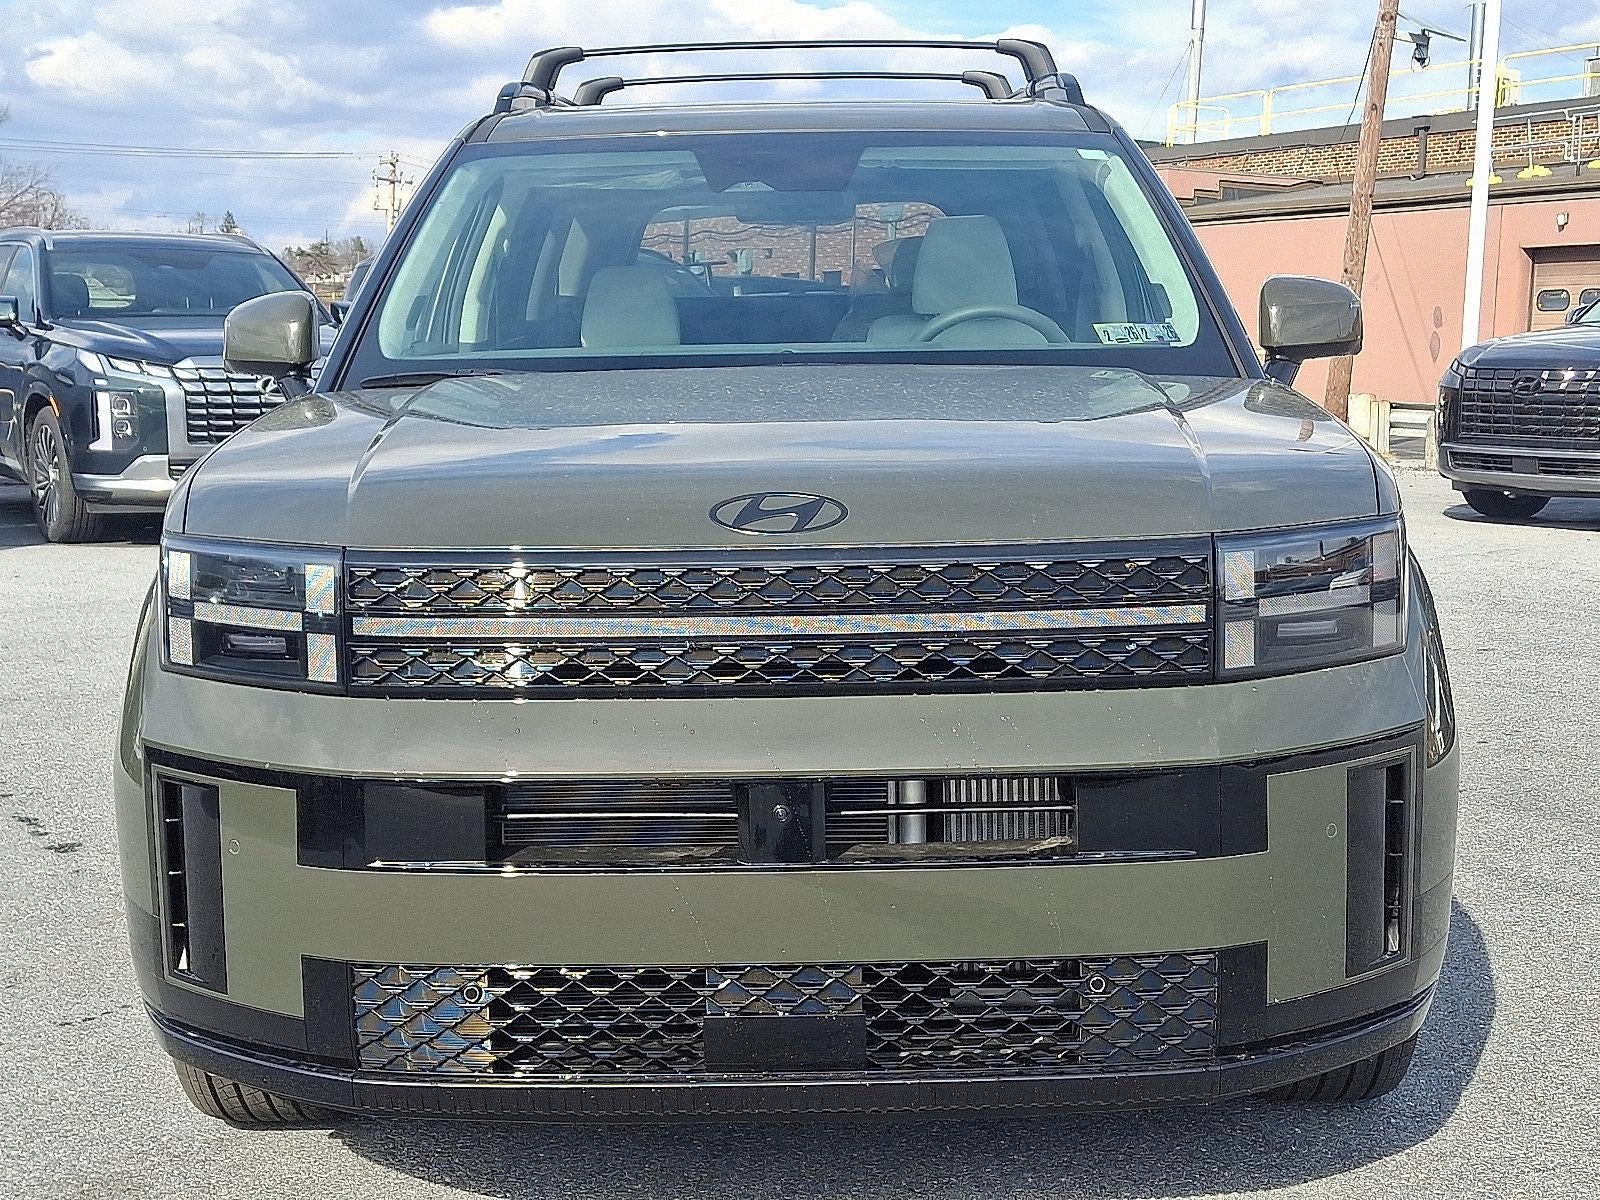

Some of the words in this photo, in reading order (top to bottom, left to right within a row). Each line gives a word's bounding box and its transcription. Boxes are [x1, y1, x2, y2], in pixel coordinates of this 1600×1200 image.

[1103, 330, 1113, 341] 2
[1124, 326, 1139, 340] 26
[1141, 328, 1151, 339] 2
